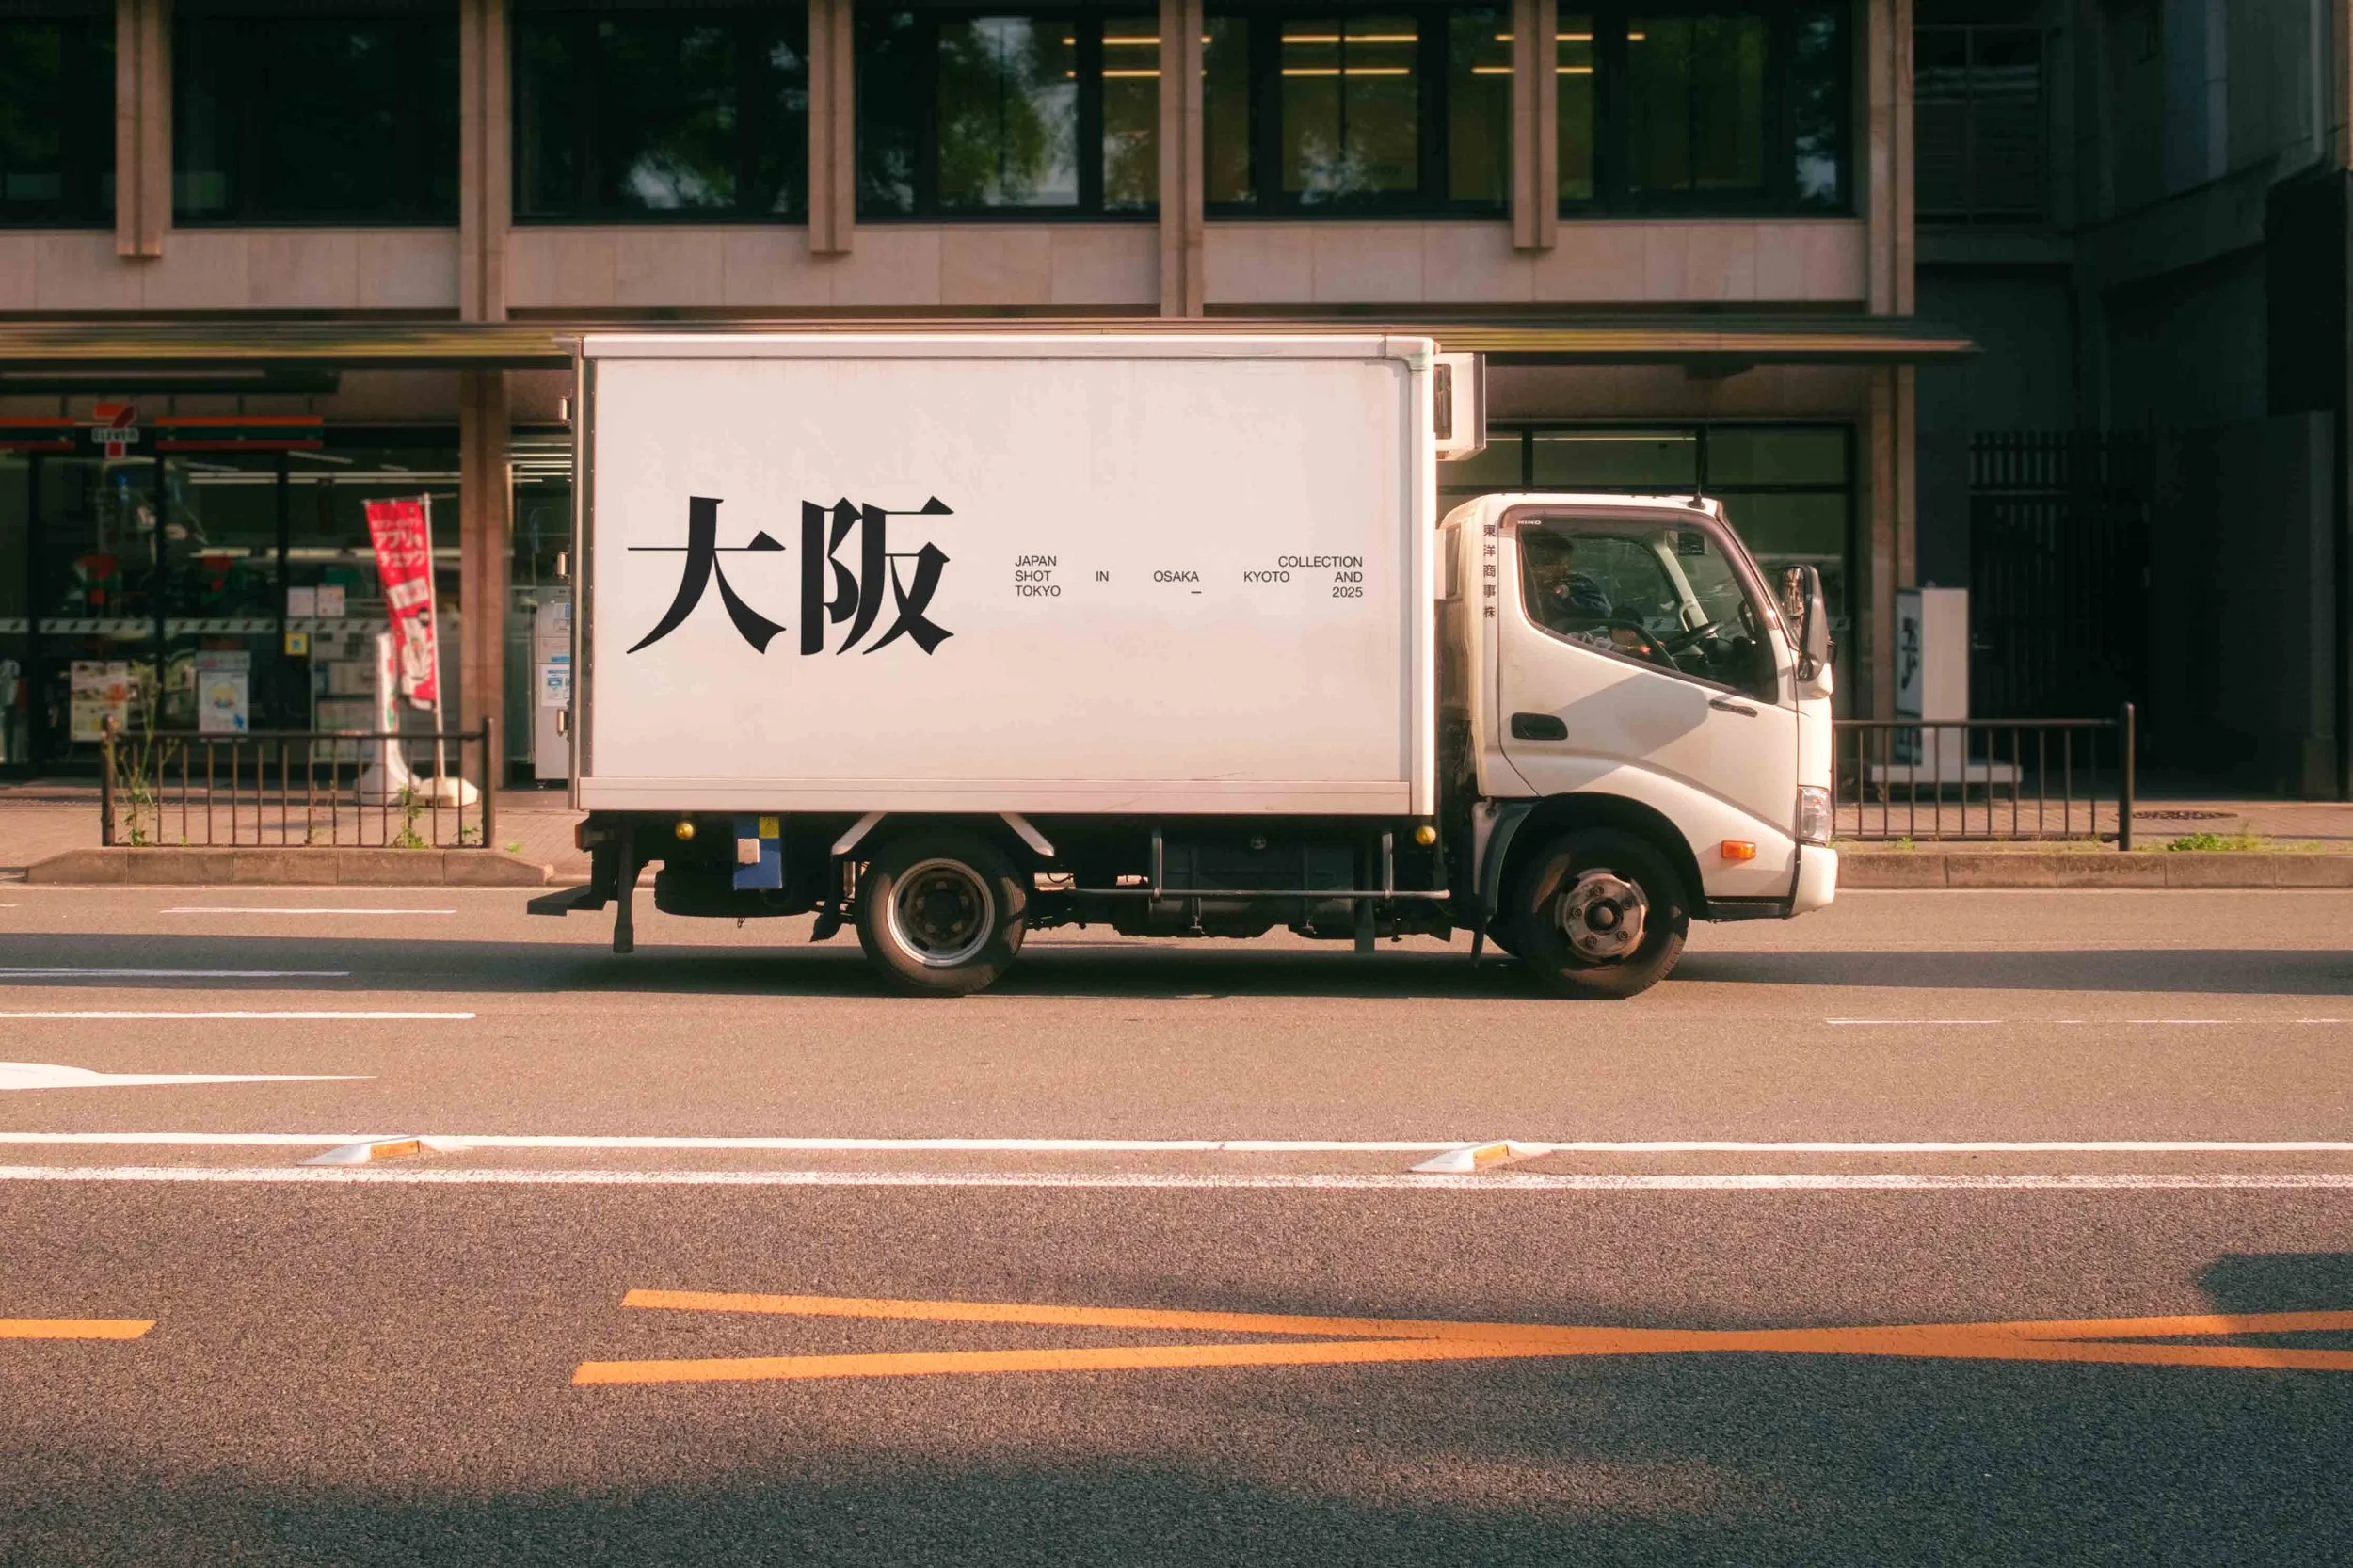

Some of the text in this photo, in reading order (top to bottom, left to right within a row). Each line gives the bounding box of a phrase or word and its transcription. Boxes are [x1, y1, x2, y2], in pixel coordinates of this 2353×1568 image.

[1015, 555, 1363, 568] JAPAN COLLECTION
[626, 495, 954, 656] 大阪
[1015, 570, 1363, 583] SHOT IN OSAKA KYOTO AND
[1482, 524, 1497, 618] 東洋商事株
[1015, 584, 1061, 597] TOKYO
[1332, 585, 1363, 598] 2025
